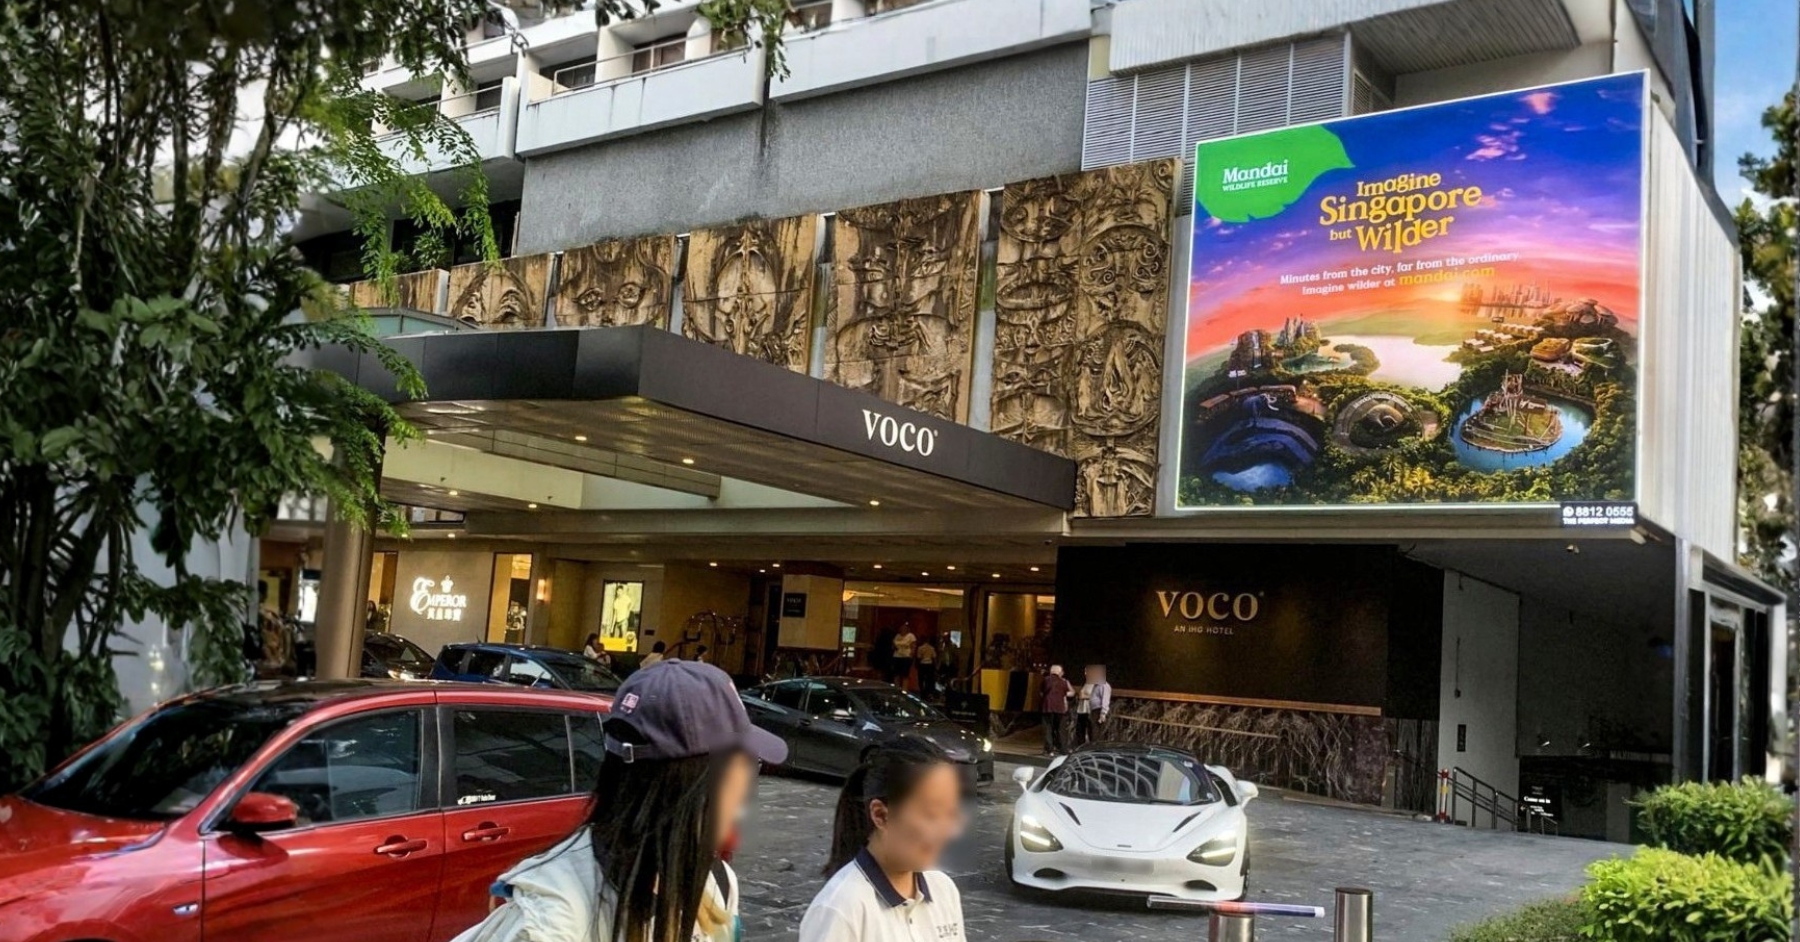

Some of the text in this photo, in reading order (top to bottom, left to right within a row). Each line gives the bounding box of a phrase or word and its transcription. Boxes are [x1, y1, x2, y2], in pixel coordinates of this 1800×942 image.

[1222, 159, 1288, 184] Mandai
[1222, 176, 1288, 191] WILDLIFE RESERVE
[1356, 172, 1441, 197] Imagine
[1319, 186, 1482, 226] Singapore
[1329, 215, 1454, 254] but Wilder
[1280, 272, 1321, 285] Minutes
[1322, 269, 1348, 281] from
[1350, 266, 1369, 277] the
[1396, 262, 1414, 273] far
[1416, 260, 1442, 271] from
[1446, 257, 1465, 267] the
[1302, 283, 1345, 295] Imagine
[1347, 280, 1381, 291] wilder
[1383, 278, 1396, 288] at
[1575, 506, 1635, 517] 8812 0555
[1174, 625, 1234, 635] AN IHG HOTEL
